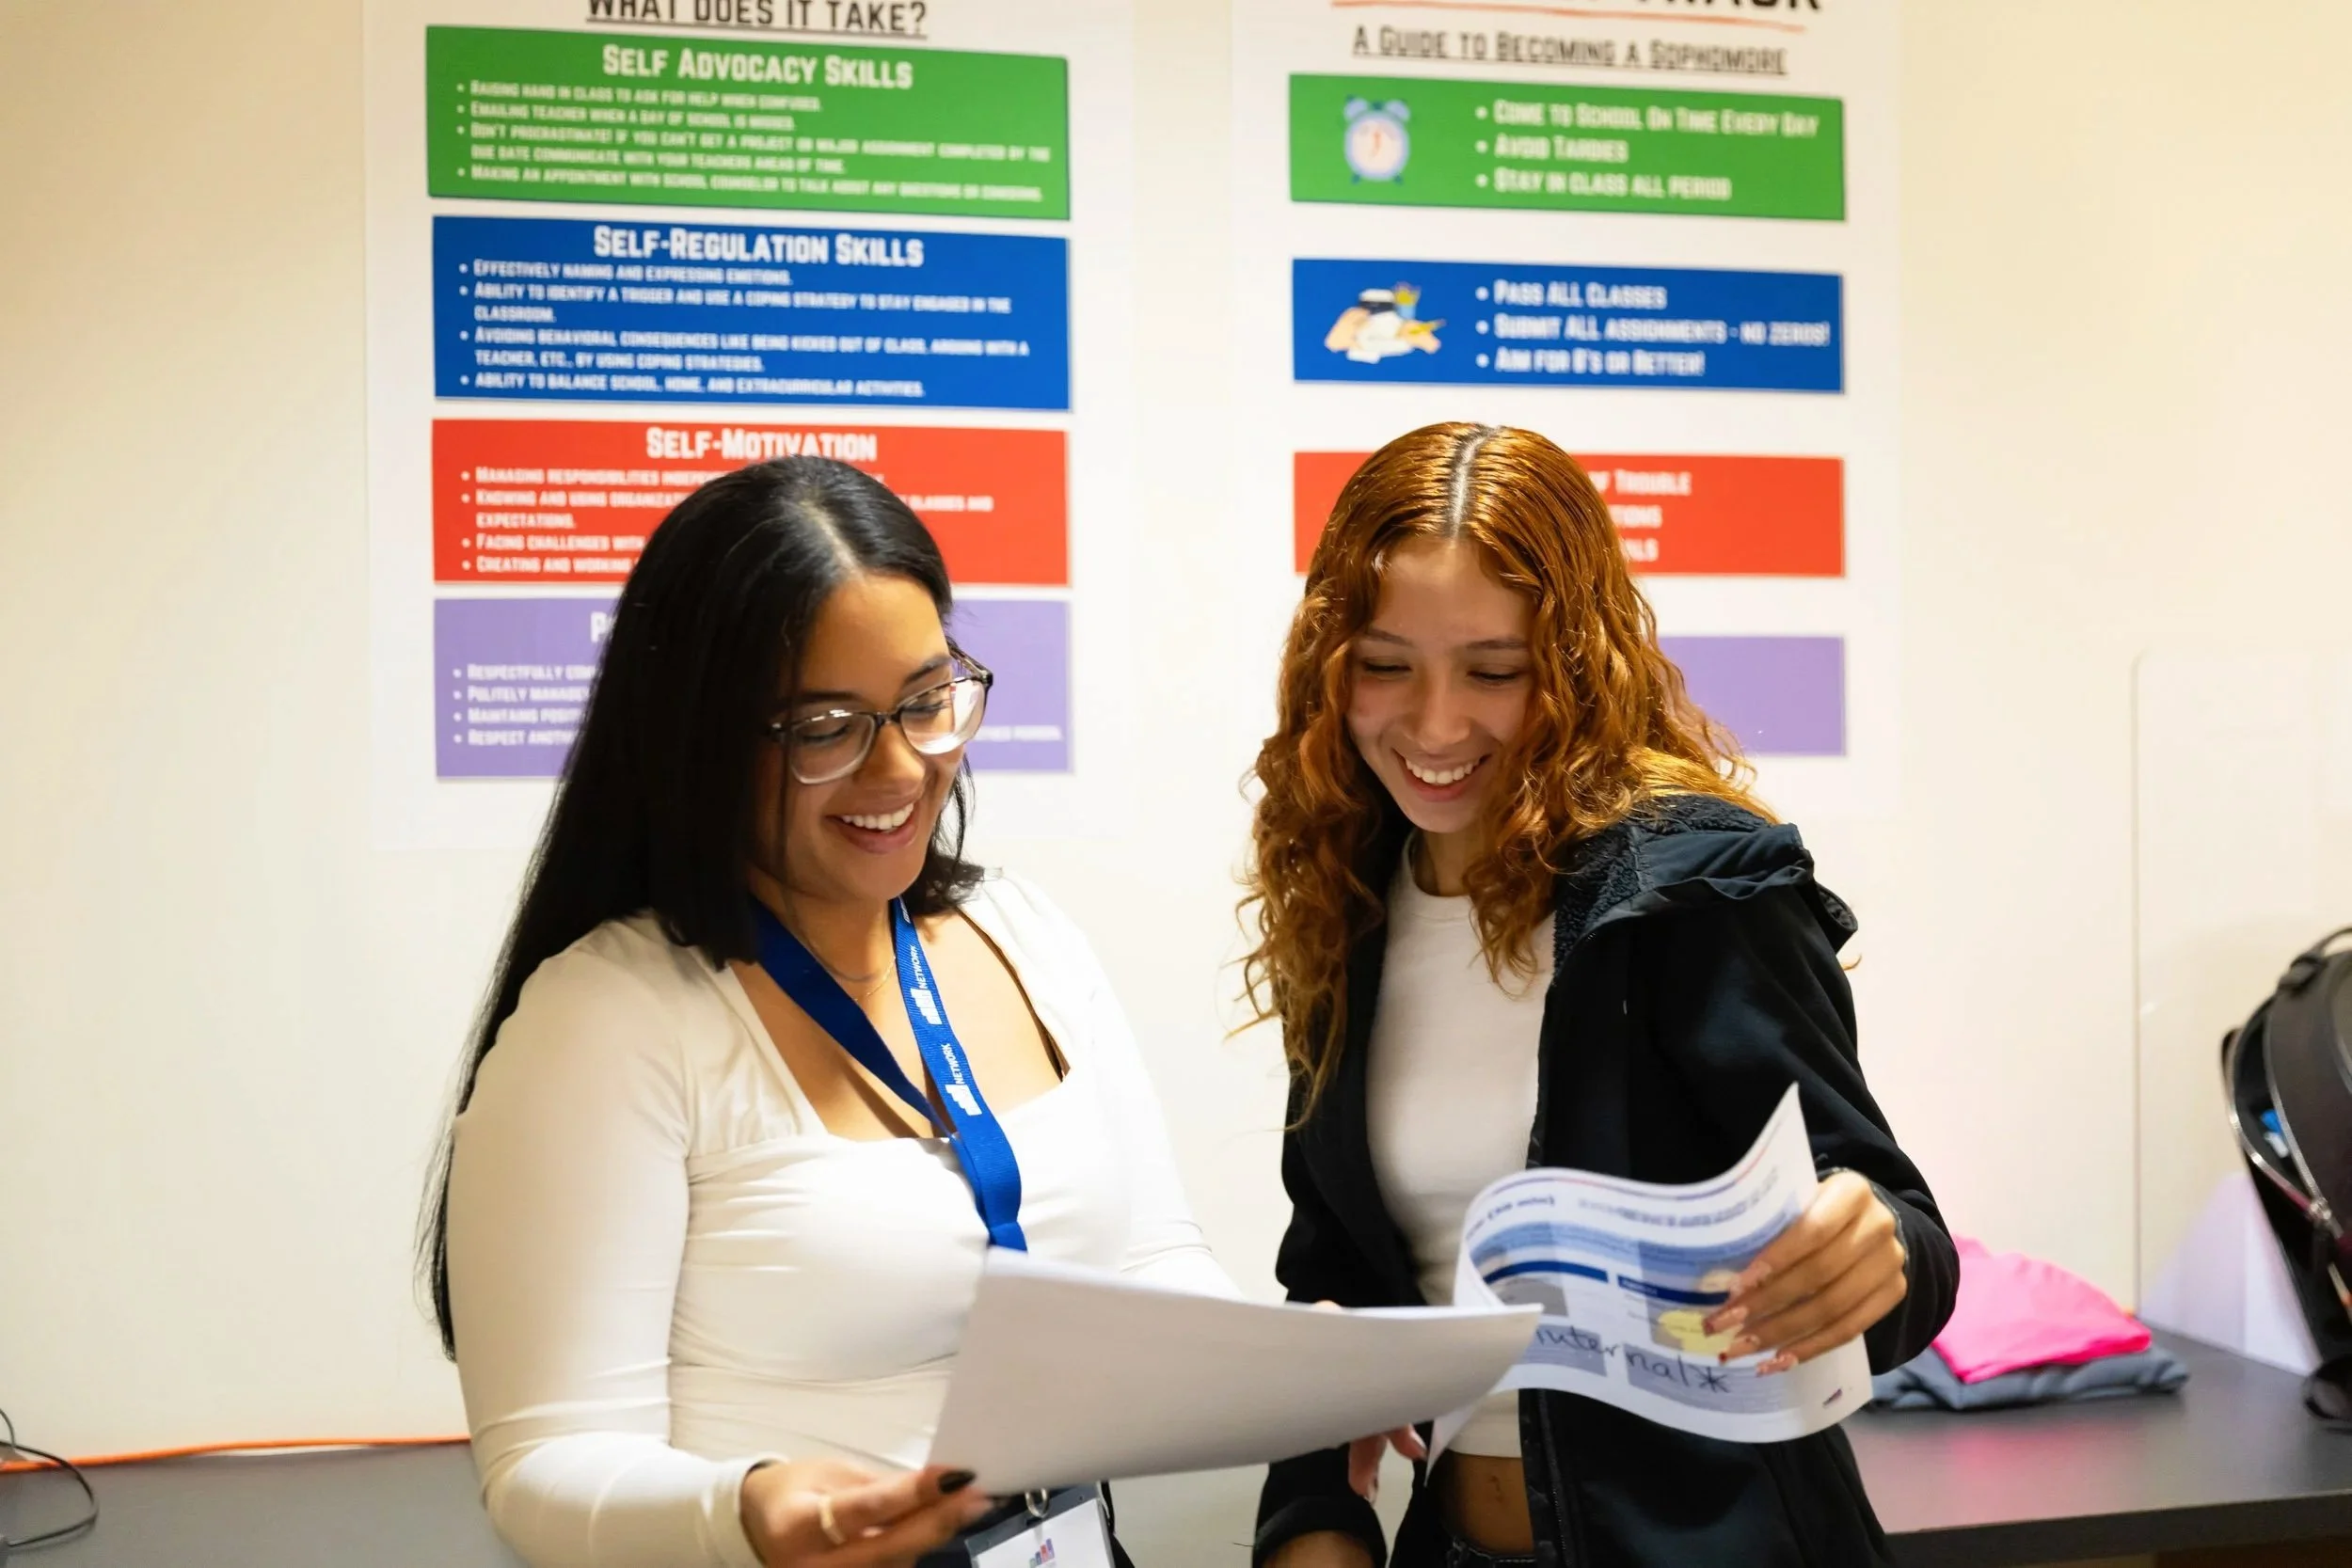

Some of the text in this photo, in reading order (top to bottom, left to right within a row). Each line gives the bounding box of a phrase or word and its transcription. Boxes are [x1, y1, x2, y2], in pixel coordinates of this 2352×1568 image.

[694, 0, 774, 25] DOES
[787, 0, 813, 27] IT
[828, 1, 928, 35] TAKE?
[603, 45, 914, 90] SELF ADVOCACY SKILLS
[1354, 25, 1788, 75] A GUIDE TO BECOMING A SOPHOMORE
[594, 225, 926, 267] SELF-REGULATION SKILLS
[645, 426, 878, 462] SELF-MOTIVATION
[910, 944, 928, 988] NETWORK
[941, 1042, 965, 1085] NETWORK
